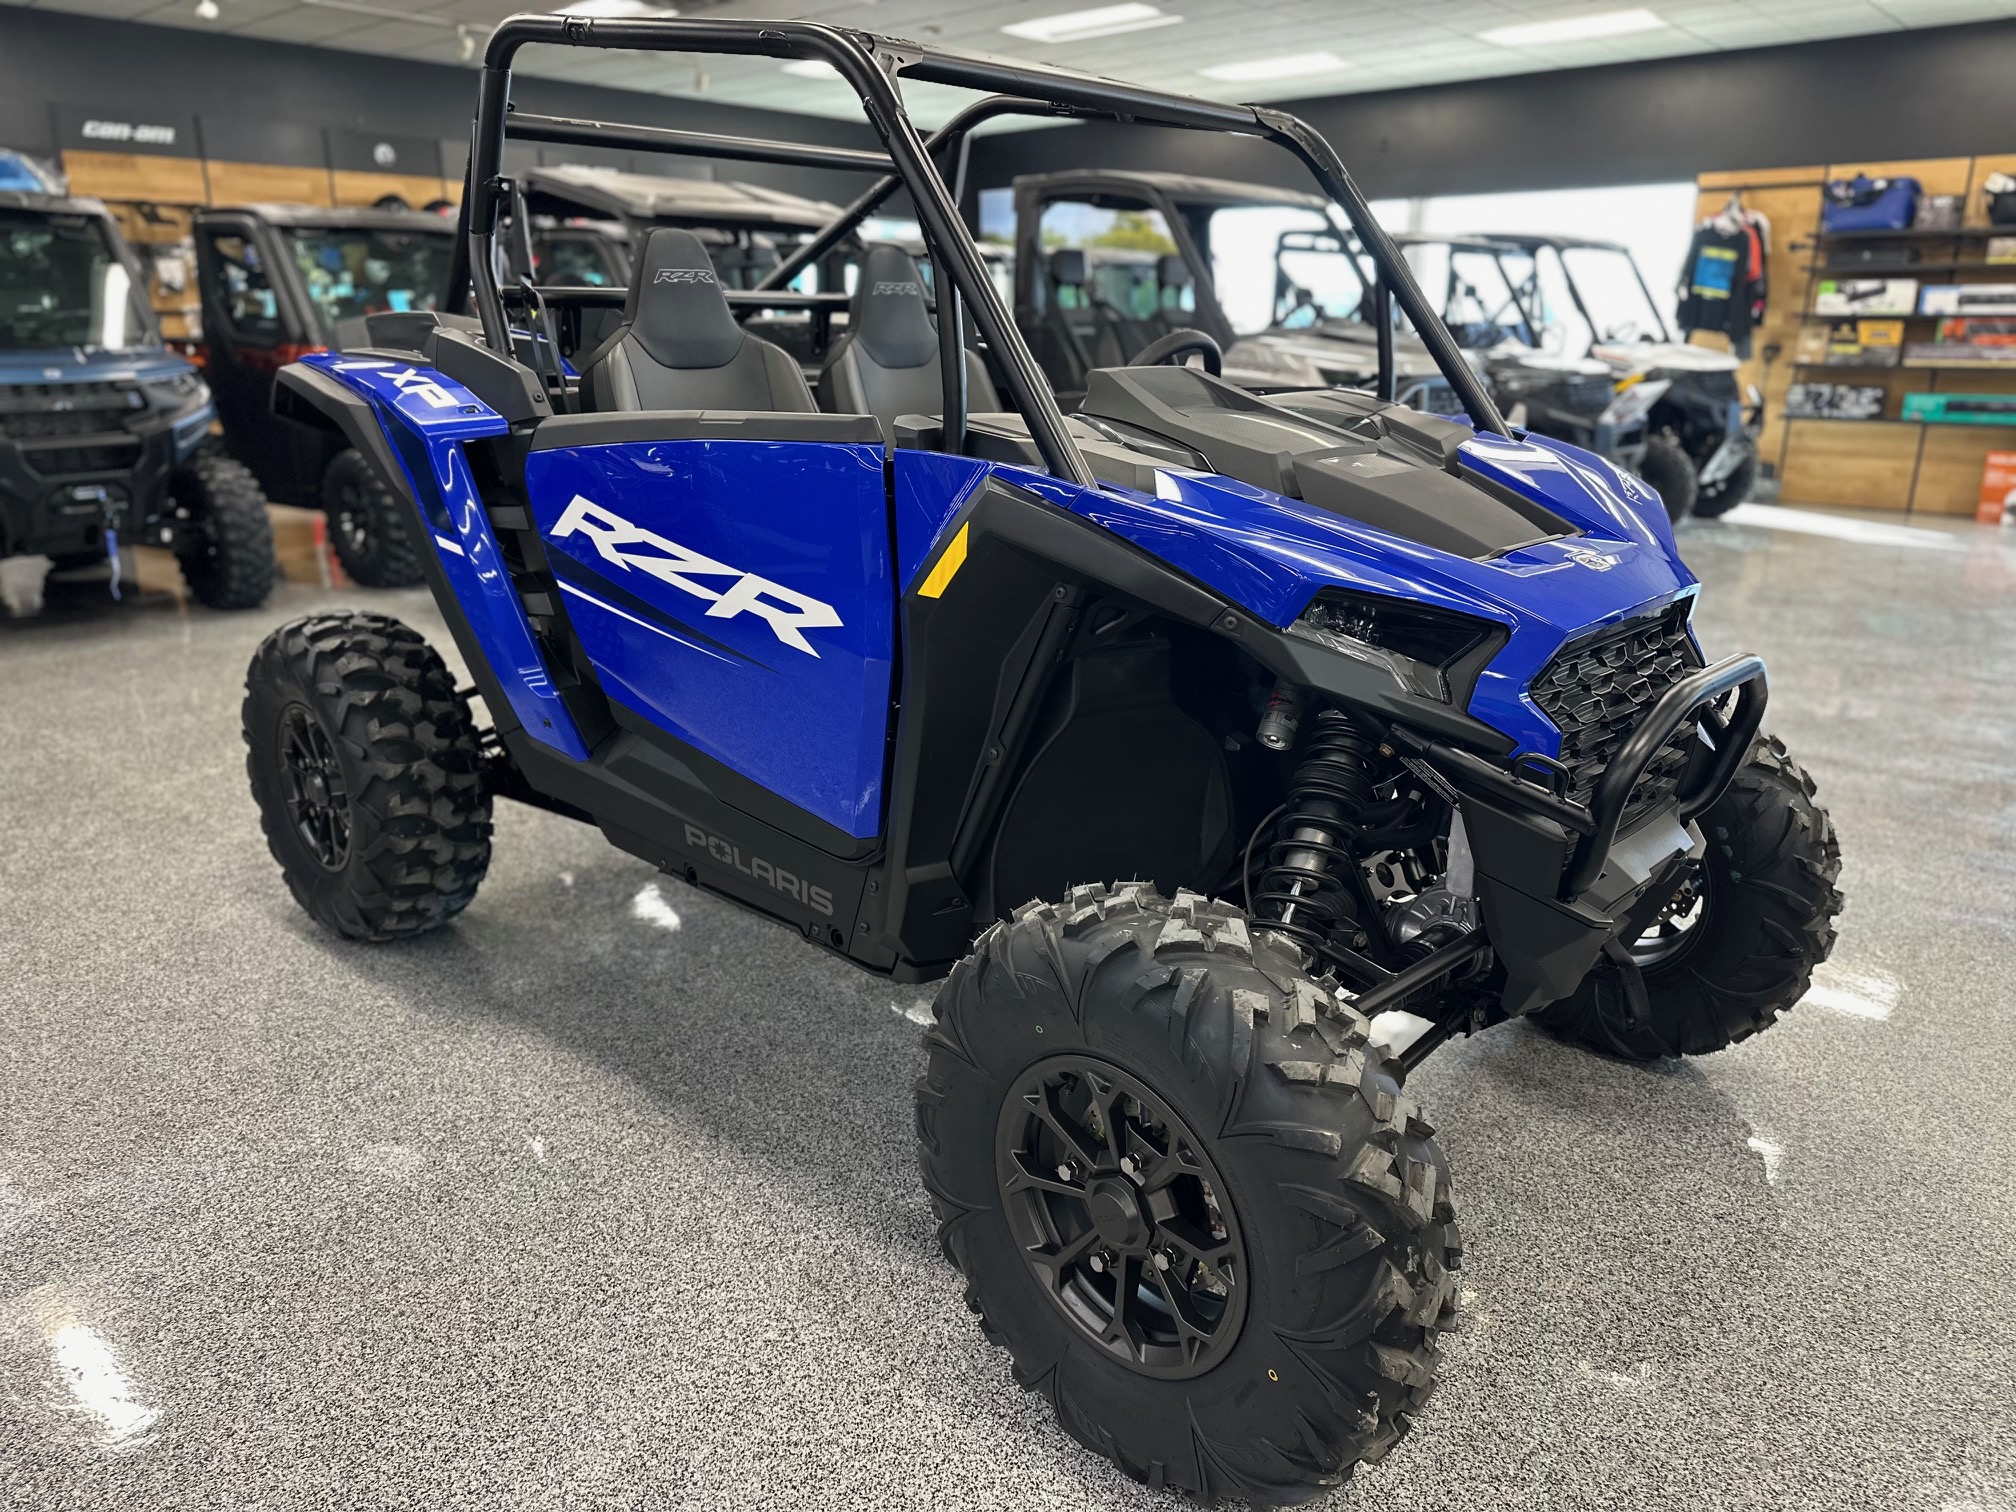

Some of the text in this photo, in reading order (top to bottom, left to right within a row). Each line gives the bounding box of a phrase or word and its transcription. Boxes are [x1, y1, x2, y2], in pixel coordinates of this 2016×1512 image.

[653, 268, 715, 284] RZR
[871, 281, 919, 296] RZR
[377, 368, 460, 409] XP
[549, 494, 845, 660] RZR
[684, 823, 834, 917] POLARIS
